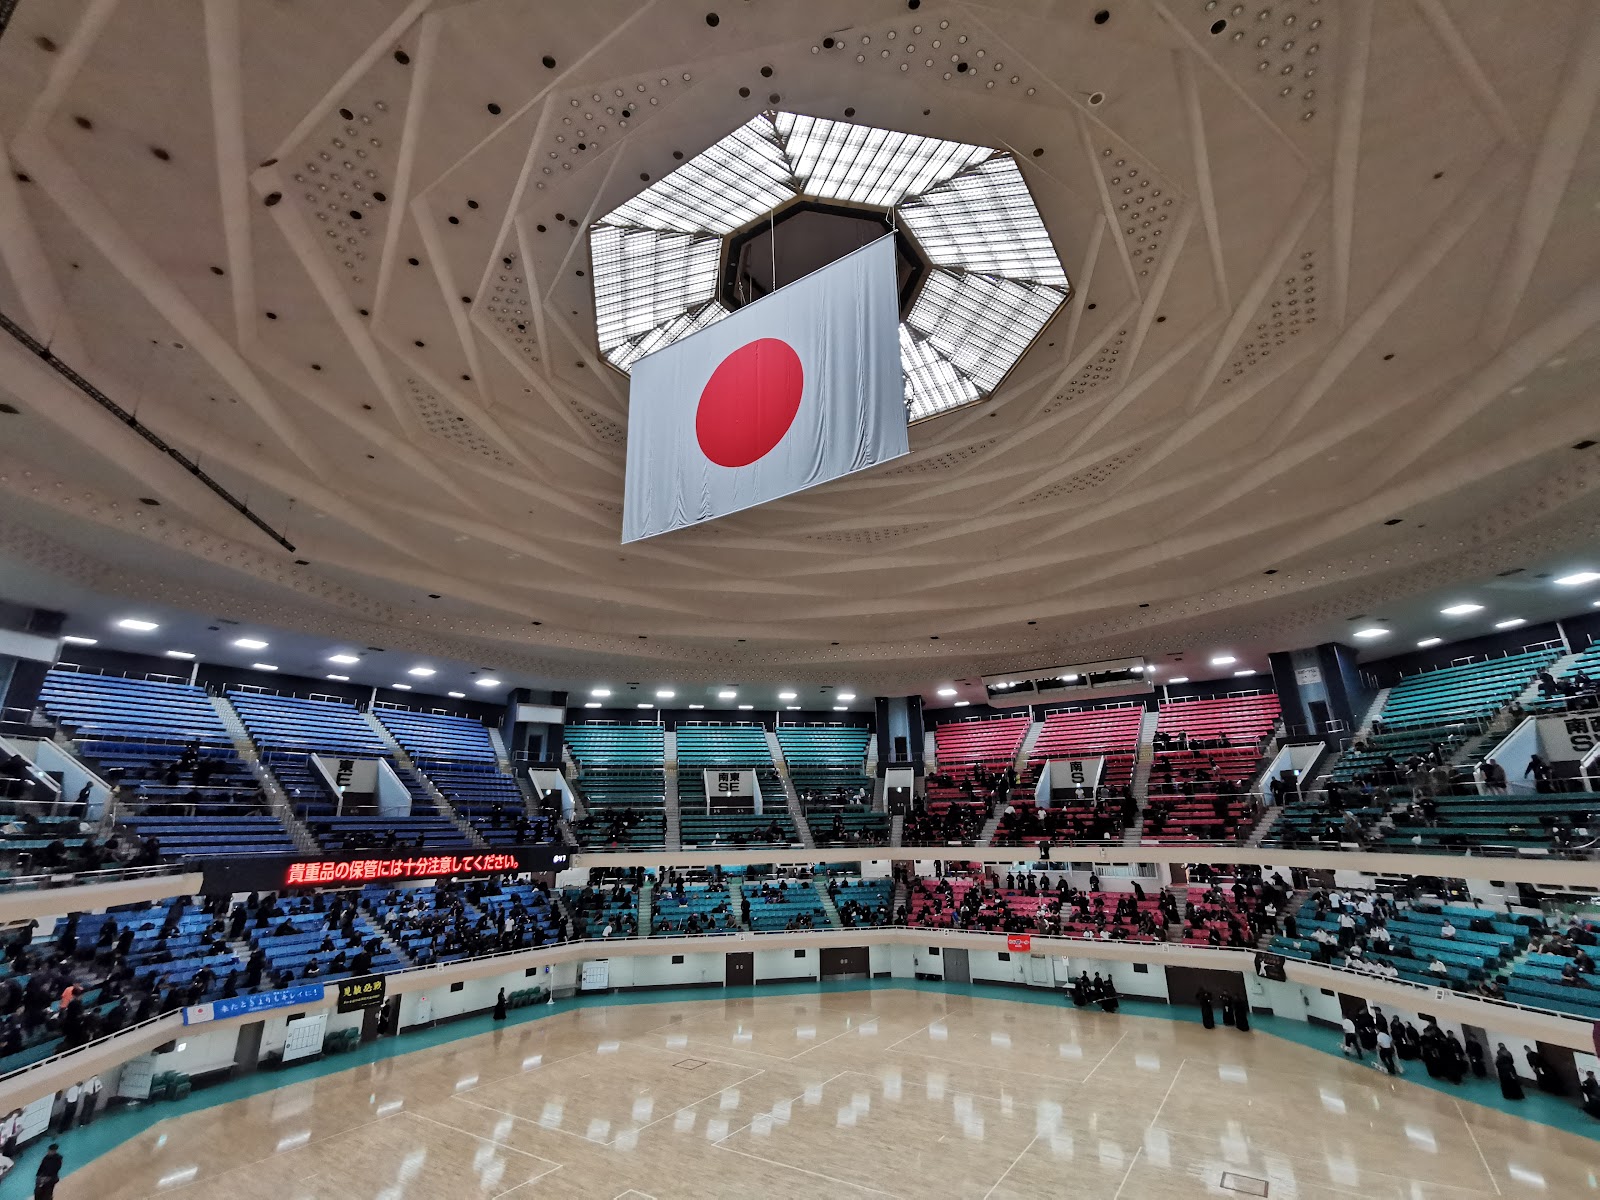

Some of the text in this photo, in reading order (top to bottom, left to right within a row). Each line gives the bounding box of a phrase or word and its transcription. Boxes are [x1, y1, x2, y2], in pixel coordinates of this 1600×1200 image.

[1570, 733, 1600, 752] S
[338, 760, 354, 772] 東
[1070, 761, 1083, 772] 南
[336, 772, 352, 786] E
[718, 772, 740, 782] 南東
[1071, 772, 1085, 784] S
[718, 782, 740, 792] SE
[287, 854, 519, 884] 貴重品の保管には十分注意してください。
